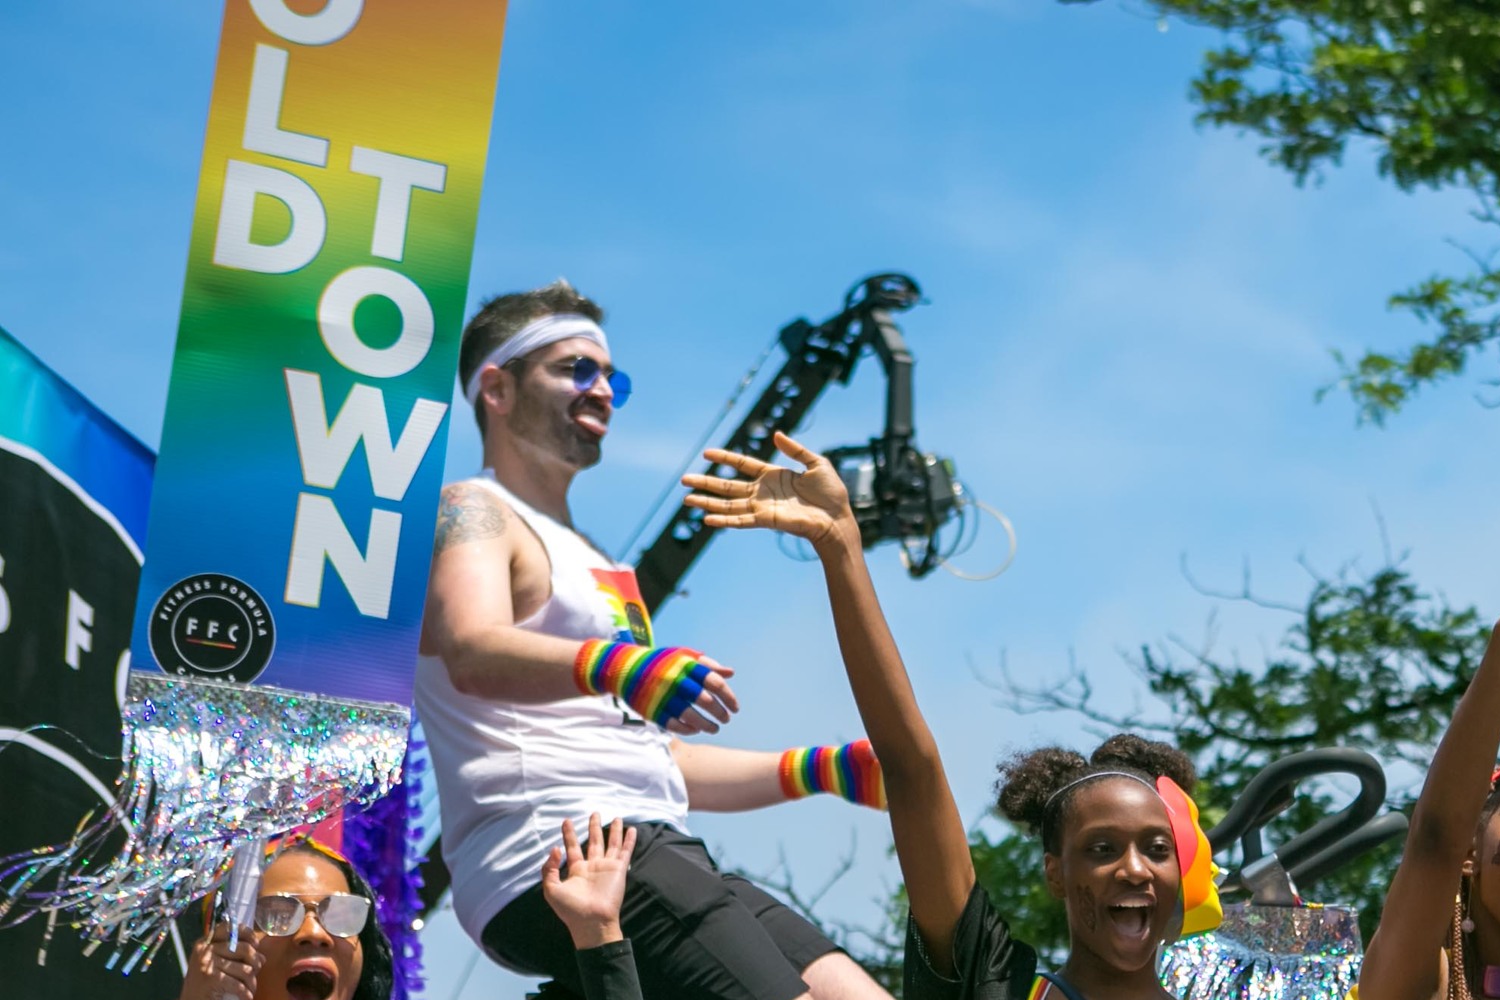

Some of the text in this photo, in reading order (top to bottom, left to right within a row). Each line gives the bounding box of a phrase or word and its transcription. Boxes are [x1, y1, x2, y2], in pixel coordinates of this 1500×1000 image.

[284, 145, 448, 620] TOWN
[159, 580, 267, 637] FITNESS FORMULA
